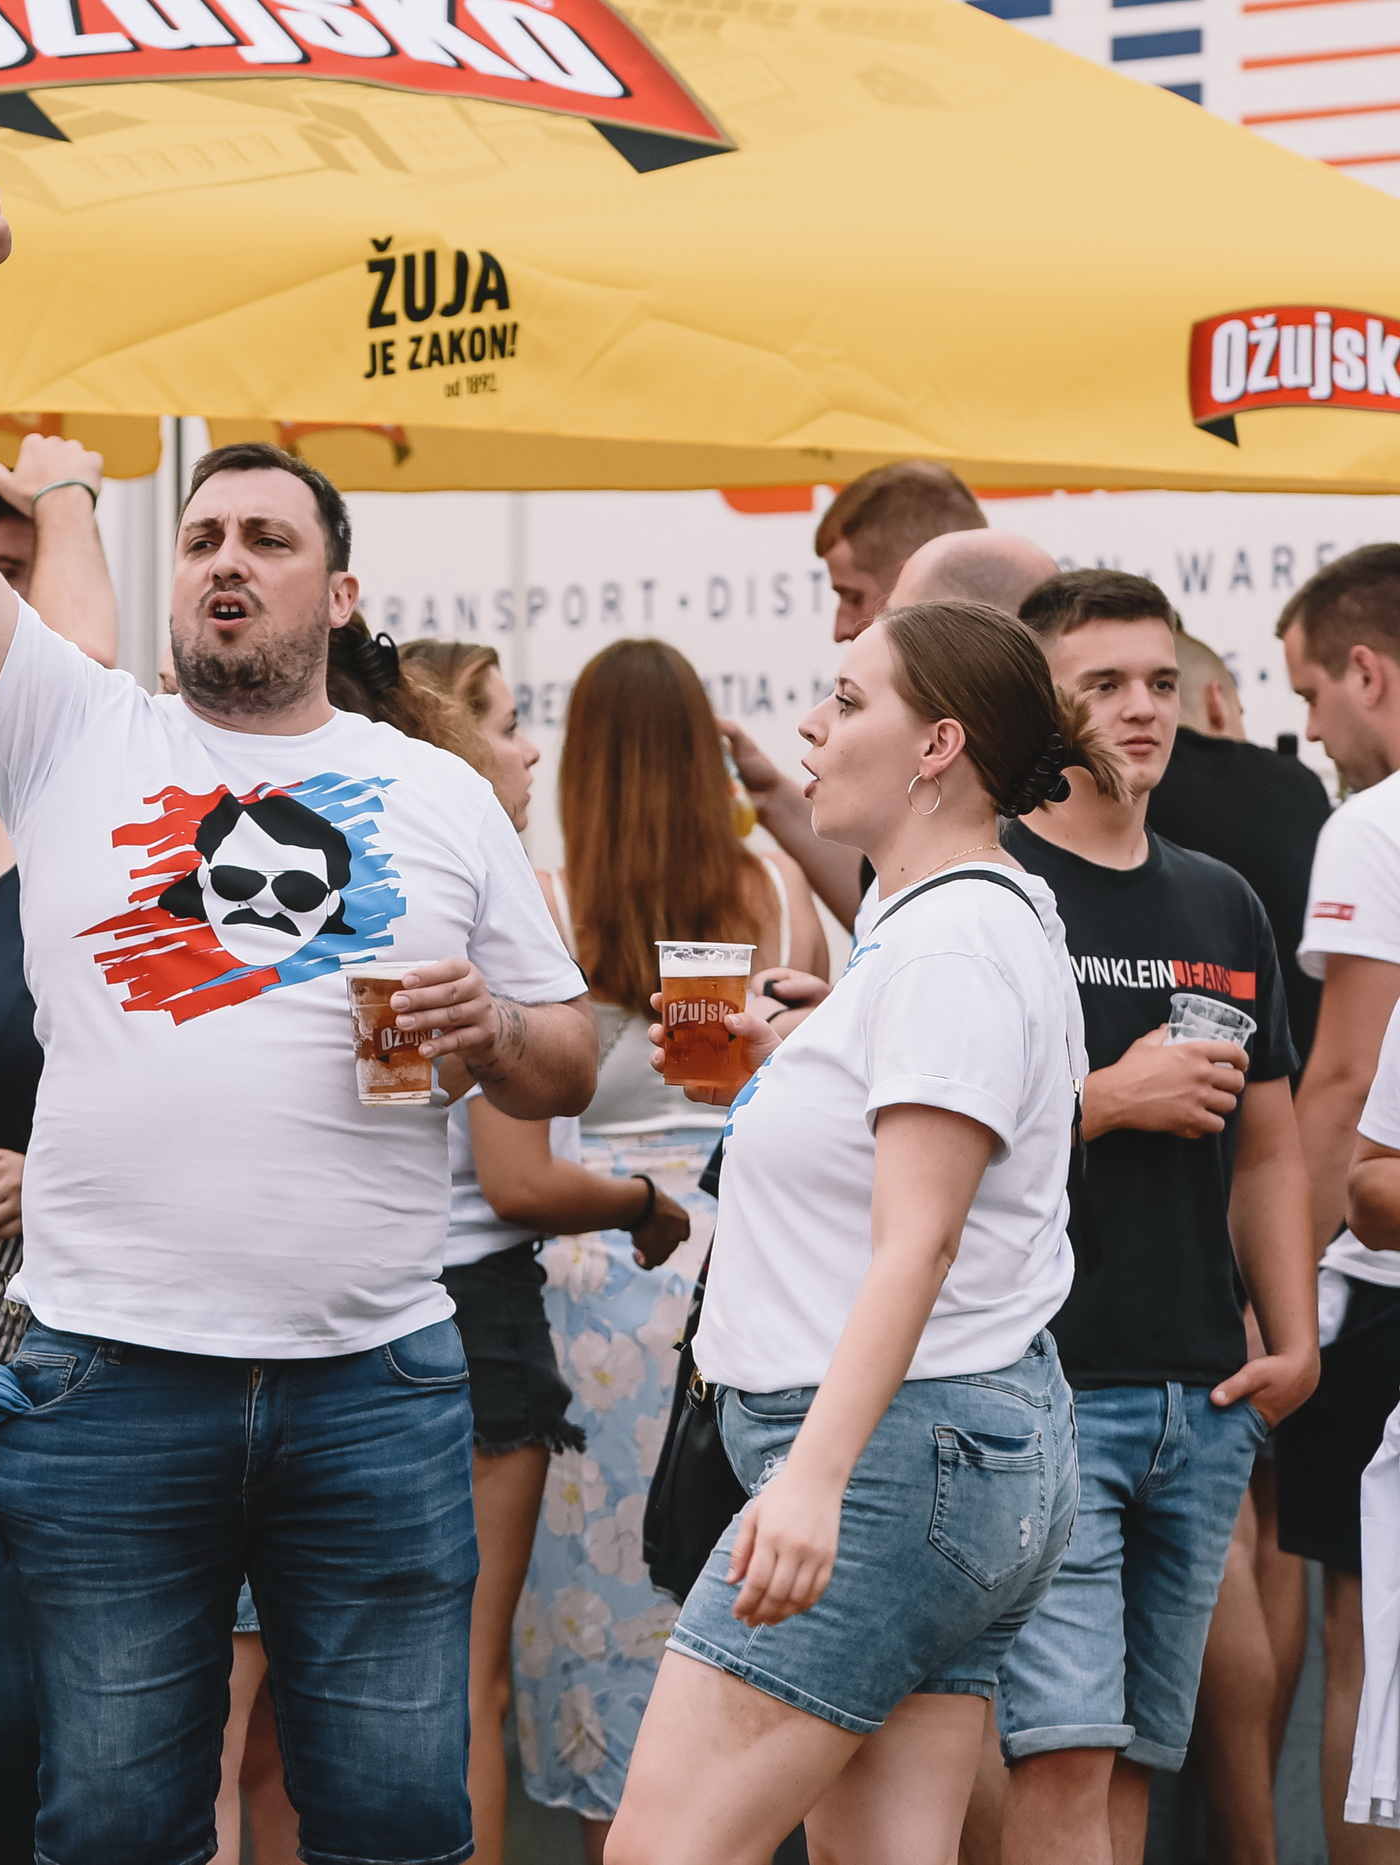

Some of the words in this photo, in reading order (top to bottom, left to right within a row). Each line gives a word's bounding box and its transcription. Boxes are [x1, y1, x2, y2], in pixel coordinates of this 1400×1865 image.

[367, 235, 510, 328] ŽUJA
[363, 340, 396, 379] JE
[408, 322, 518, 370] ZAKON!
[1210, 311, 1400, 404] Ožujsk
[358, 577, 662, 638] RANSPORT
[1069, 955, 1177, 989] VINKLEIN
